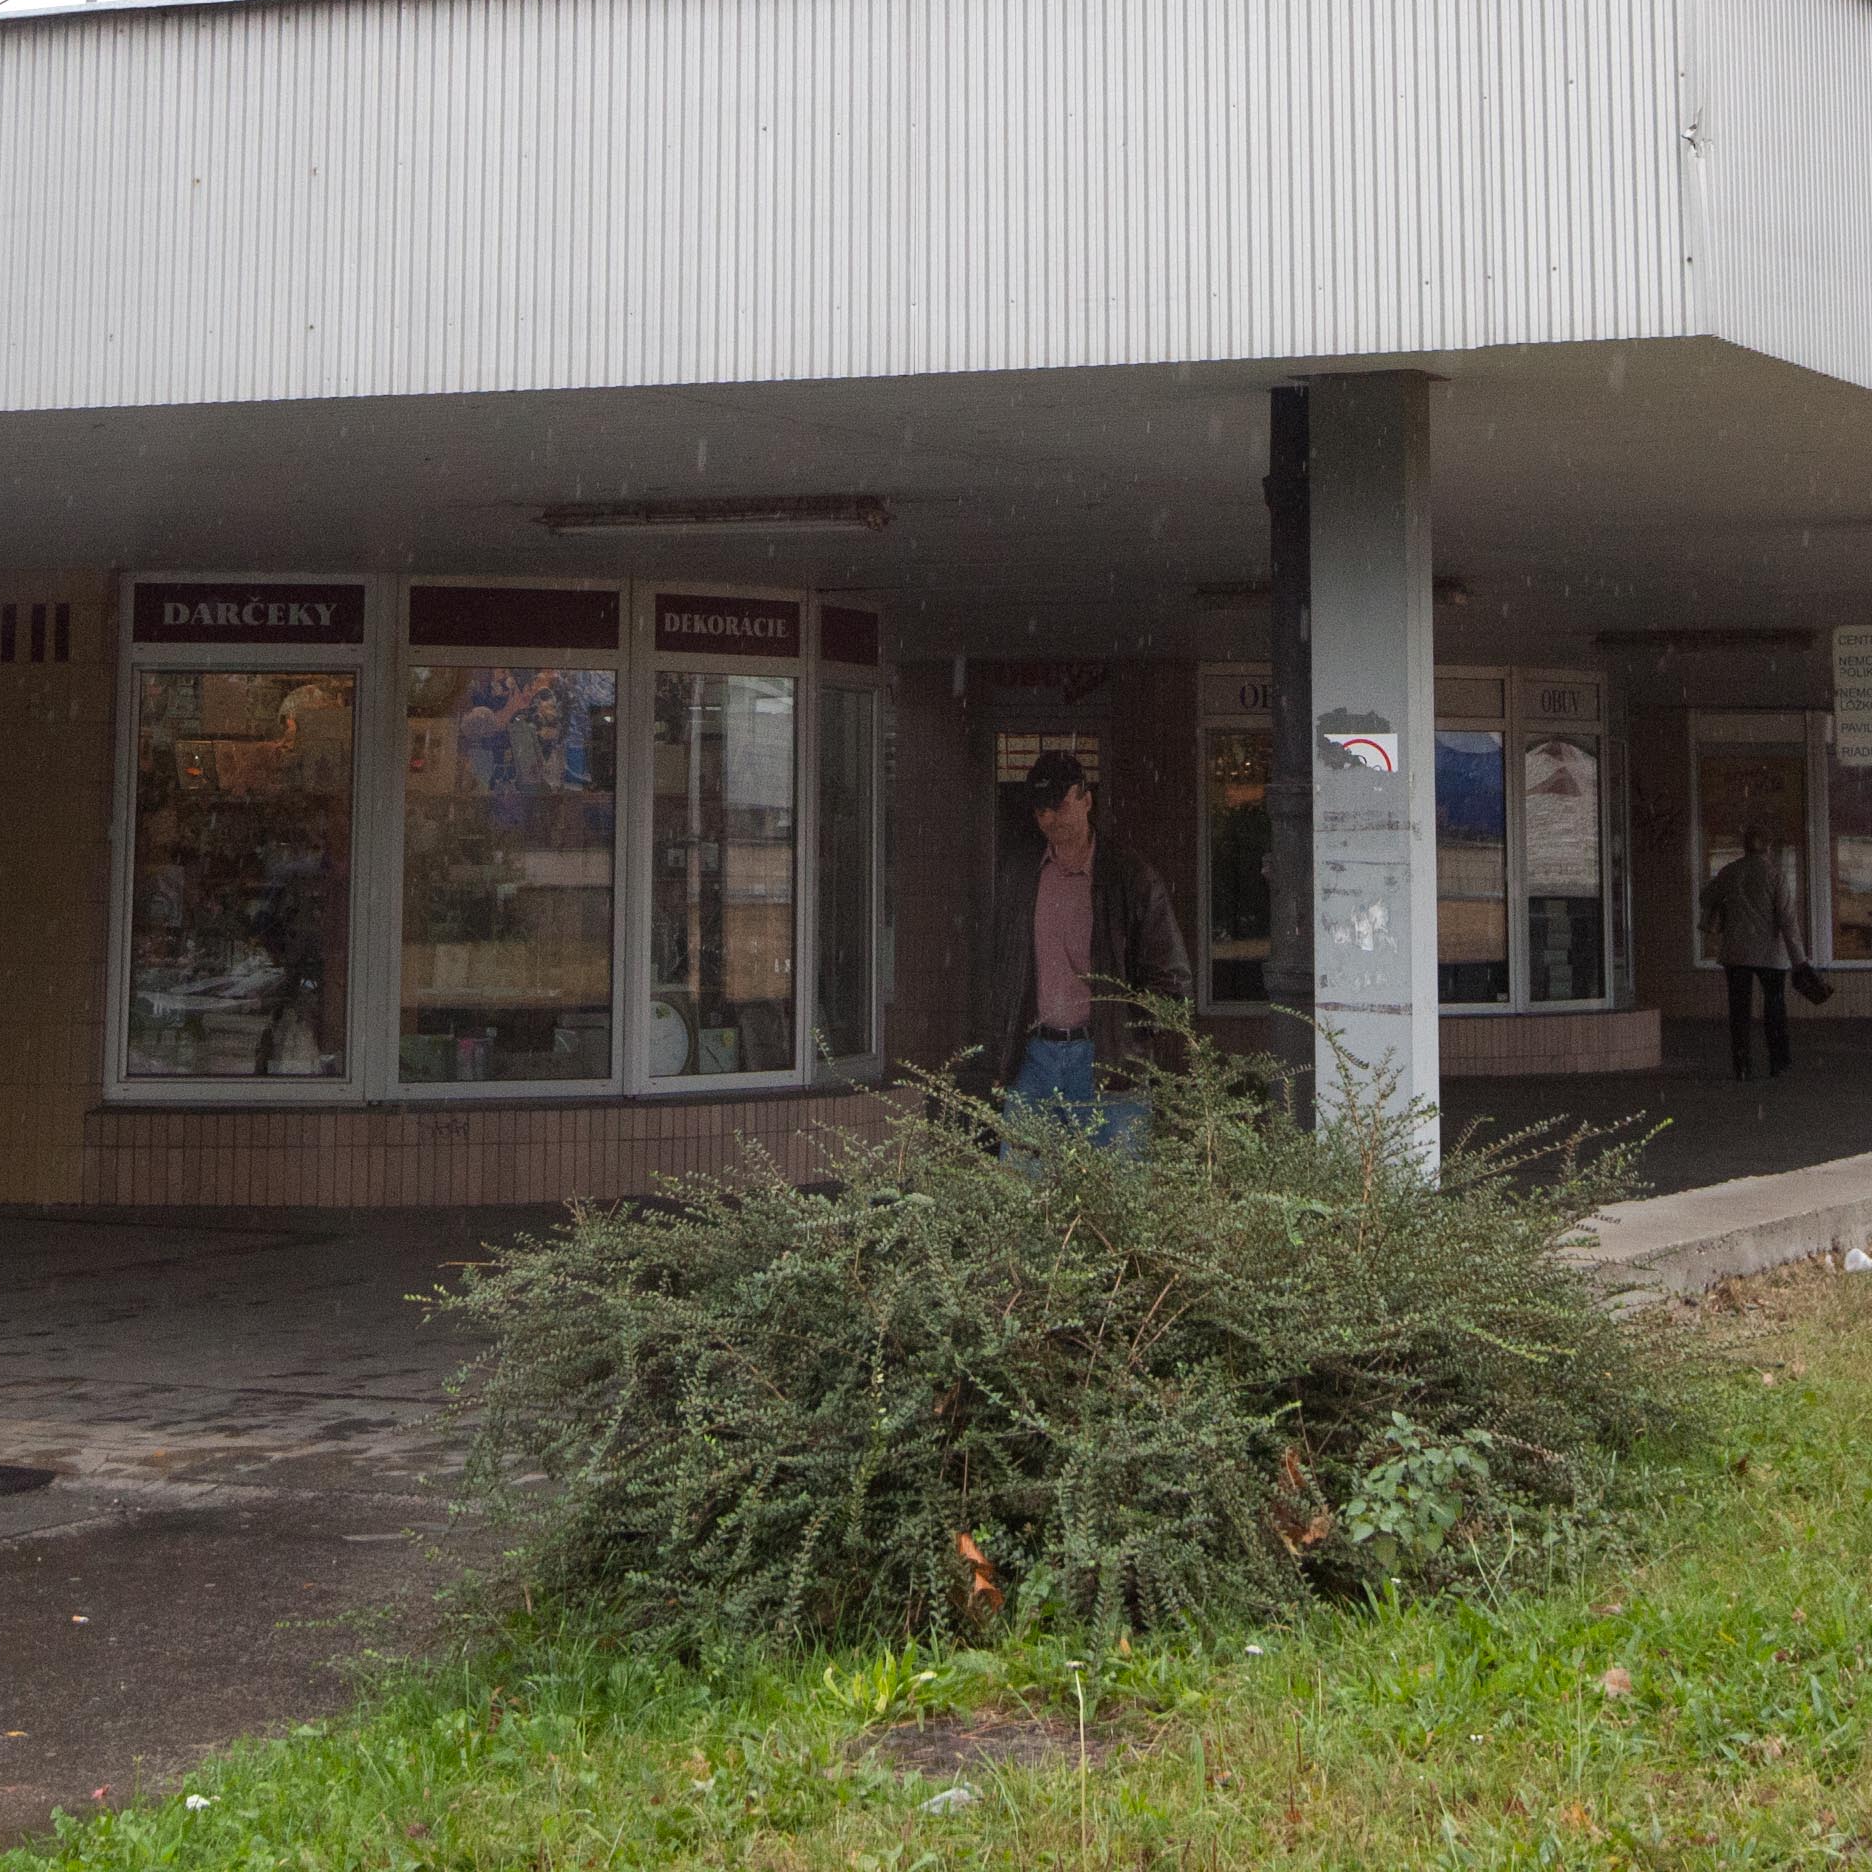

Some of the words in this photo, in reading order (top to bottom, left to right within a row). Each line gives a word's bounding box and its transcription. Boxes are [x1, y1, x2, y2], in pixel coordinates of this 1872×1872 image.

[162, 596, 337, 626] DARČEKY
[664, 611, 789, 639] DEKORÁCIE
[1541, 689, 1581, 714] OBUV
